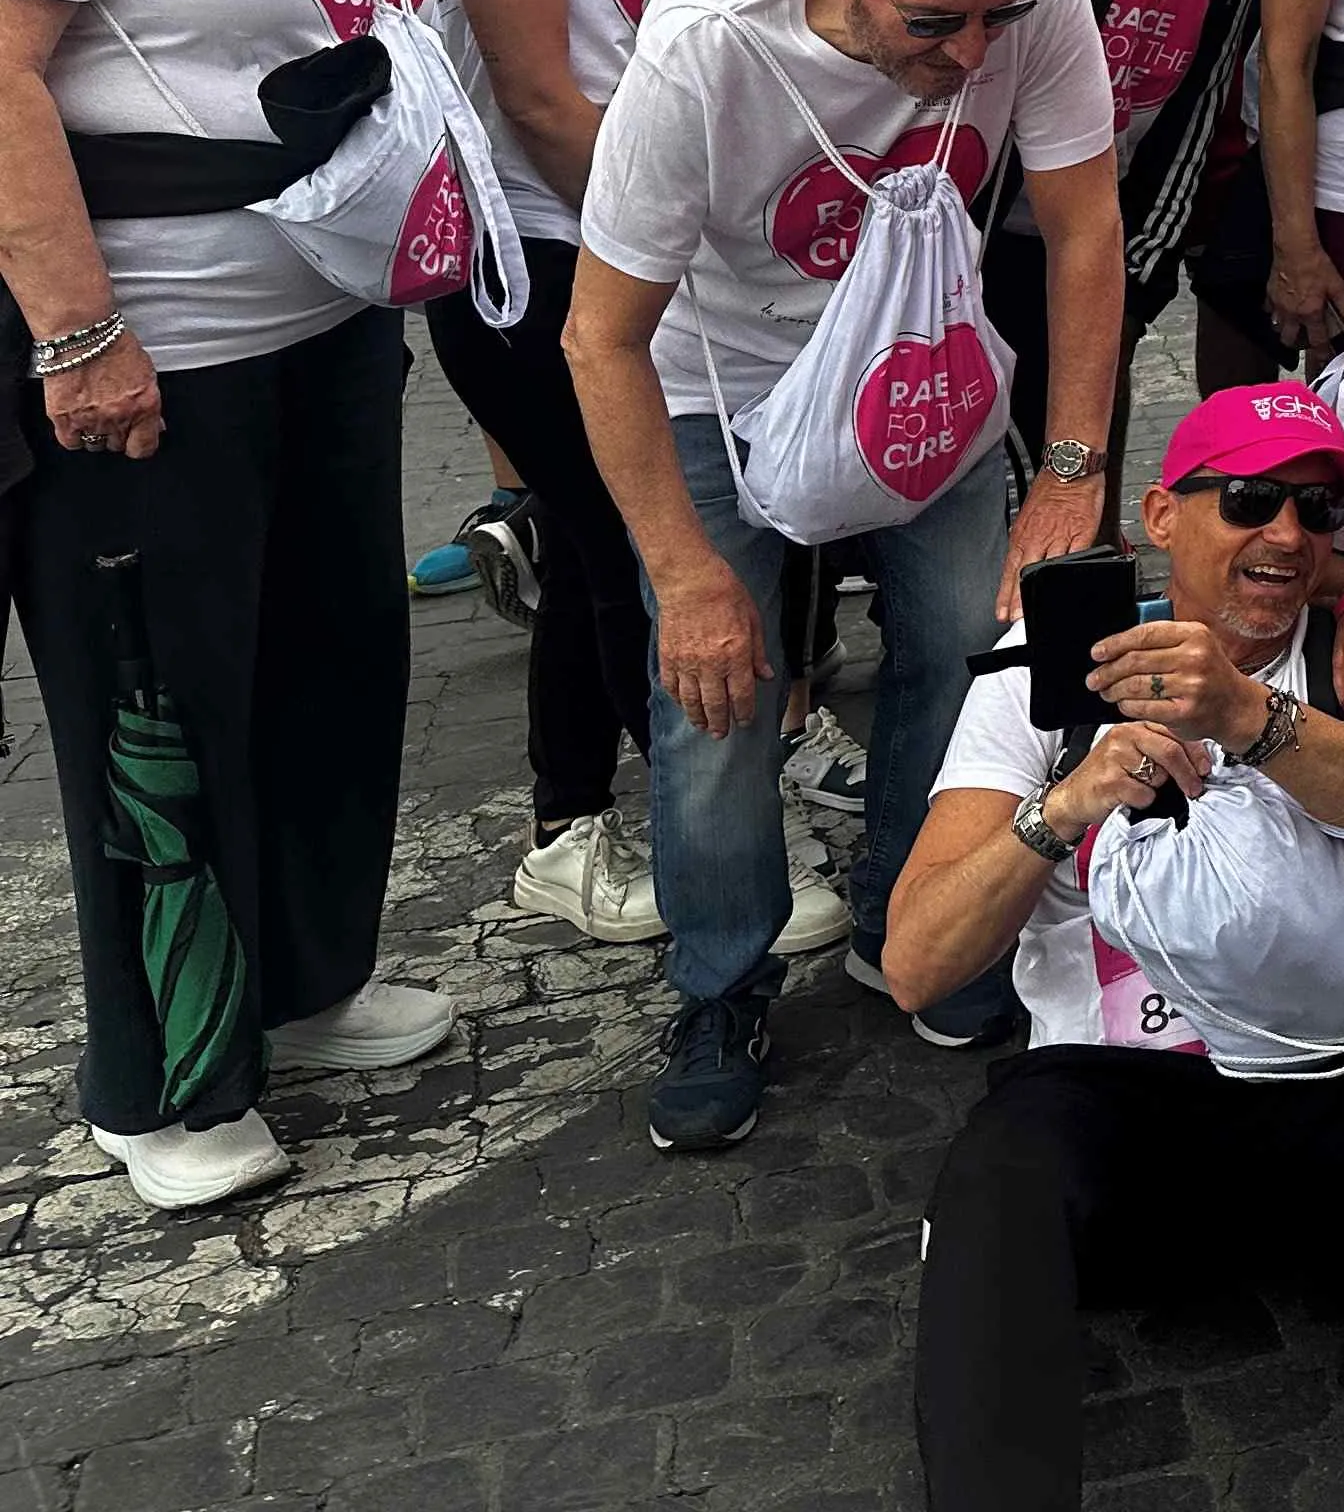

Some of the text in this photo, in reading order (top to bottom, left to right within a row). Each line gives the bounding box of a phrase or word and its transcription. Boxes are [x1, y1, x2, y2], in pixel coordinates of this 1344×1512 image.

[1105, 1, 1177, 38] RACE
[1143, 39, 1193, 74] THE
[888, 378, 984, 440] FO THE
[1269, 395, 1333, 428] GHC
[884, 428, 956, 472] CURE
